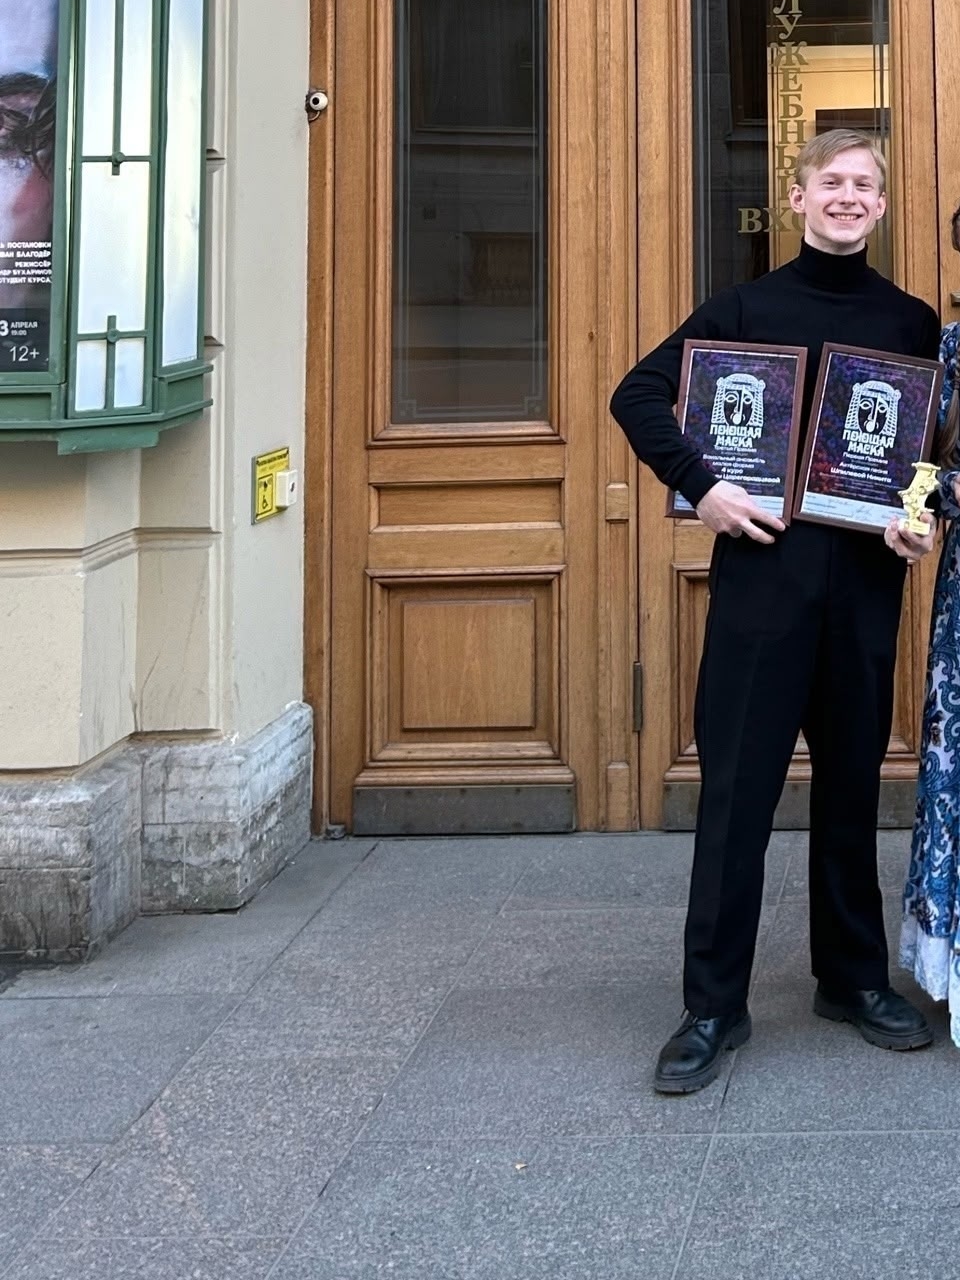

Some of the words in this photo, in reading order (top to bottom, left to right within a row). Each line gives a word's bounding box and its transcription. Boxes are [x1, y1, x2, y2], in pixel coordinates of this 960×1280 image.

[10, 321, 38, 329] АПРЕЛЯ
[9, 345, 40, 362] 12+
[715, 435, 753, 448] МАСКА
[847, 441, 885, 457] МАСКА
